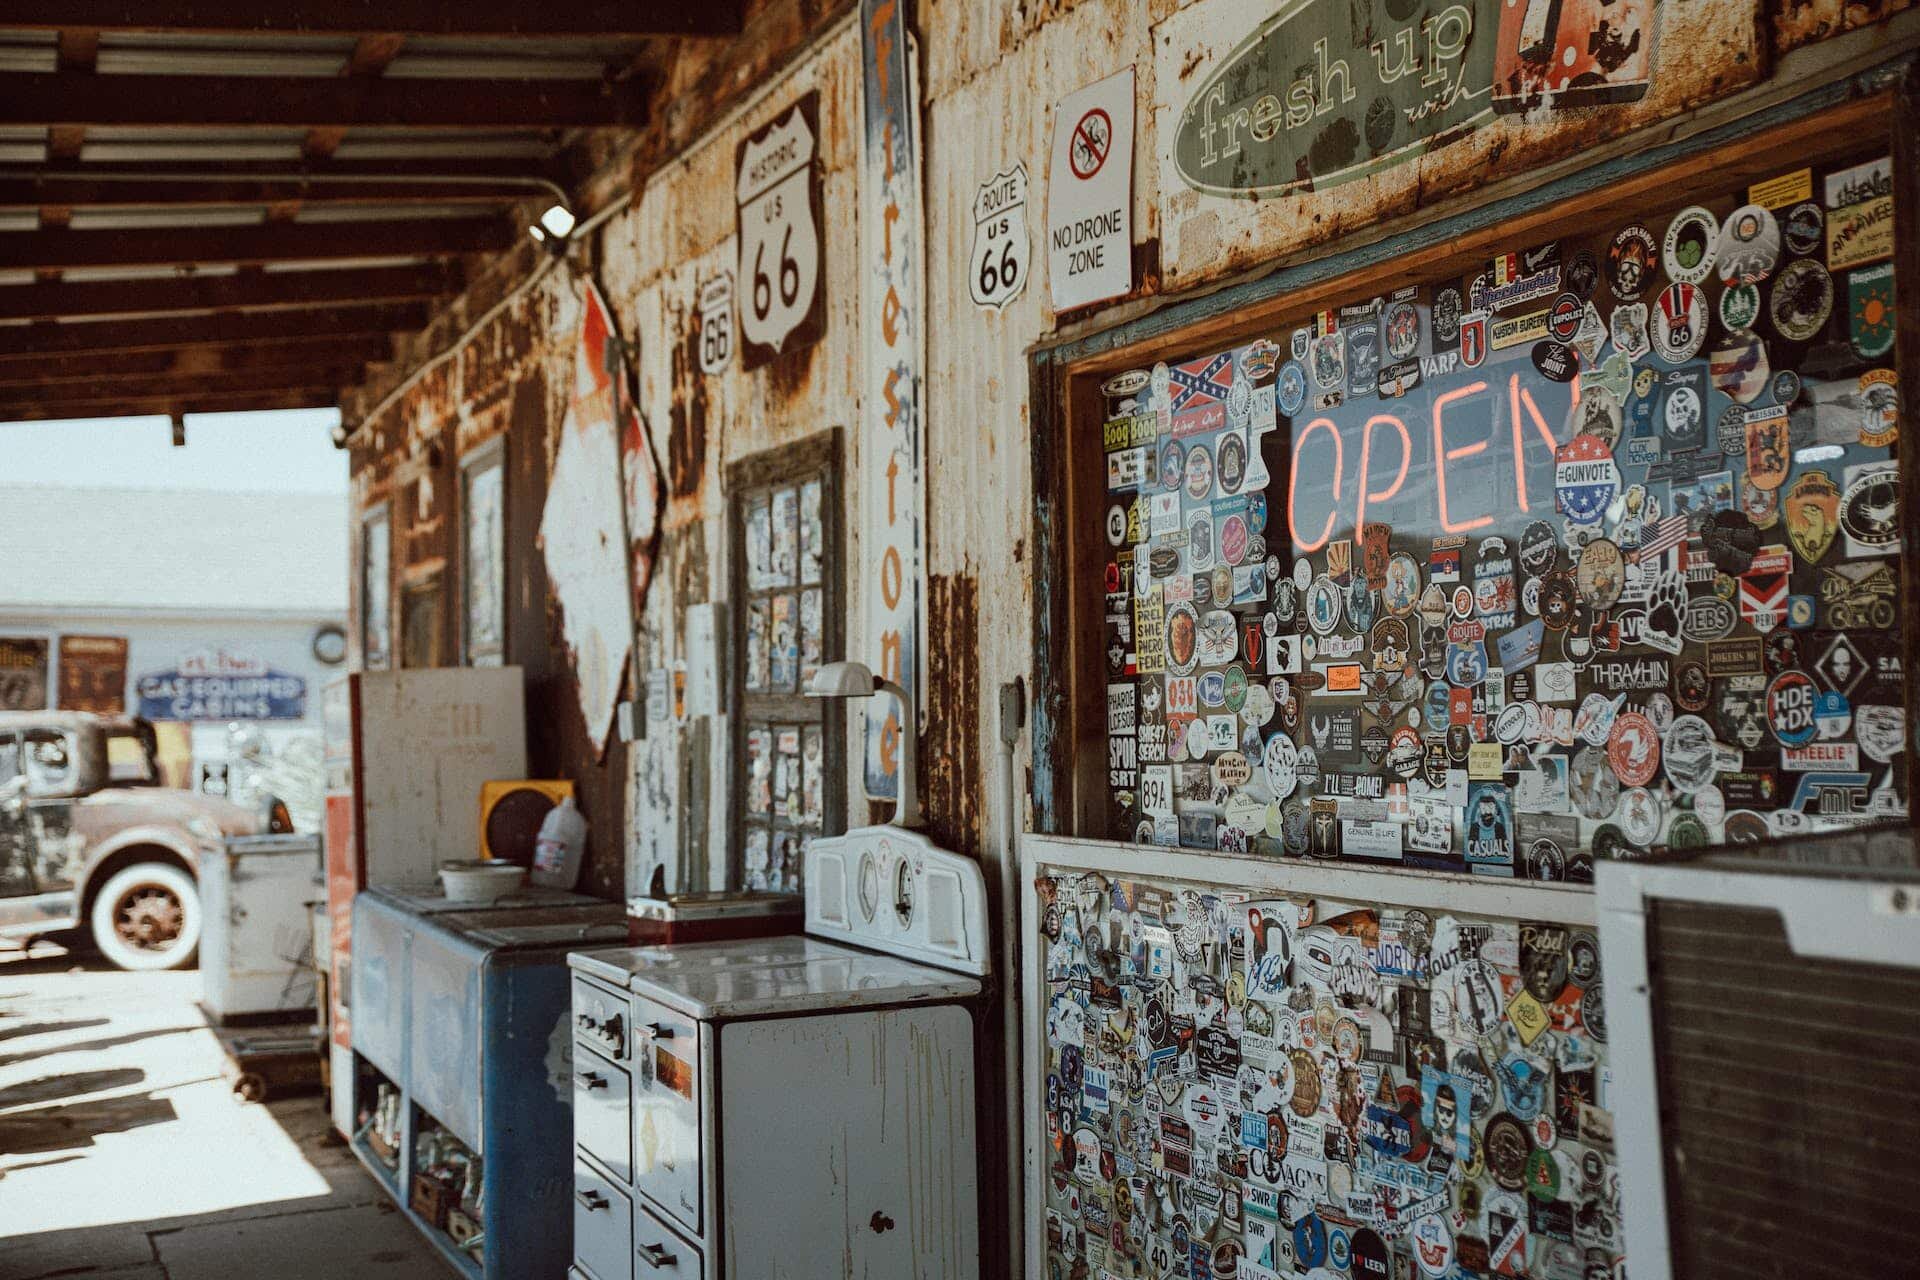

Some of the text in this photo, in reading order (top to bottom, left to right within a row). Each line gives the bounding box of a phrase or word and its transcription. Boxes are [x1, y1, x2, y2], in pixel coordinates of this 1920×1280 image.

[1403, 63, 1500, 122] with
[983, 178, 1018, 214] ROUTE
[763, 195, 782, 224] US
[987, 218, 1009, 240] US
[1053, 209, 1122, 251] NO DRONE
[753, 223, 800, 322] 66
[979, 240, 1019, 297] 66
[1069, 250, 1105, 277] ZONE
[704, 311, 728, 366] 66
[1671, 326, 1690, 346] 66
[1541, 359, 1567, 375] JOINT
[1748, 407, 1784, 420] MEISSEN
[1103, 423, 1130, 449] Boog
[1288, 372, 1580, 552] OPEN
[1557, 462, 1611, 482] #GUNVOTE
[1686, 605, 1729, 632] JEBS
[1452, 625, 1480, 640] ROUTE
[1452, 651, 1483, 682] 66
[1637, 680, 1668, 689] COMPANY
[1788, 706, 1814, 731] DX
[1138, 743, 1167, 762] SERCH
[1786, 746, 1847, 761] WHEELIE
[1394, 759, 1421, 772] GARAGE
[1109, 770, 1137, 787] SRT
[1142, 779, 1168, 811] 89A
[1347, 827, 1398, 839] GENUINE LIFE
[1467, 838, 1511, 858] CASUALS
[1520, 926, 1567, 953] Rebel
[1431, 948, 1460, 977] OUT
[1251, 1187, 1270, 1204] SWR
[1248, 1219, 1266, 1239] SWR
[1151, 1245, 1169, 1272] 40
[1363, 1257, 1387, 1276] LEEN
